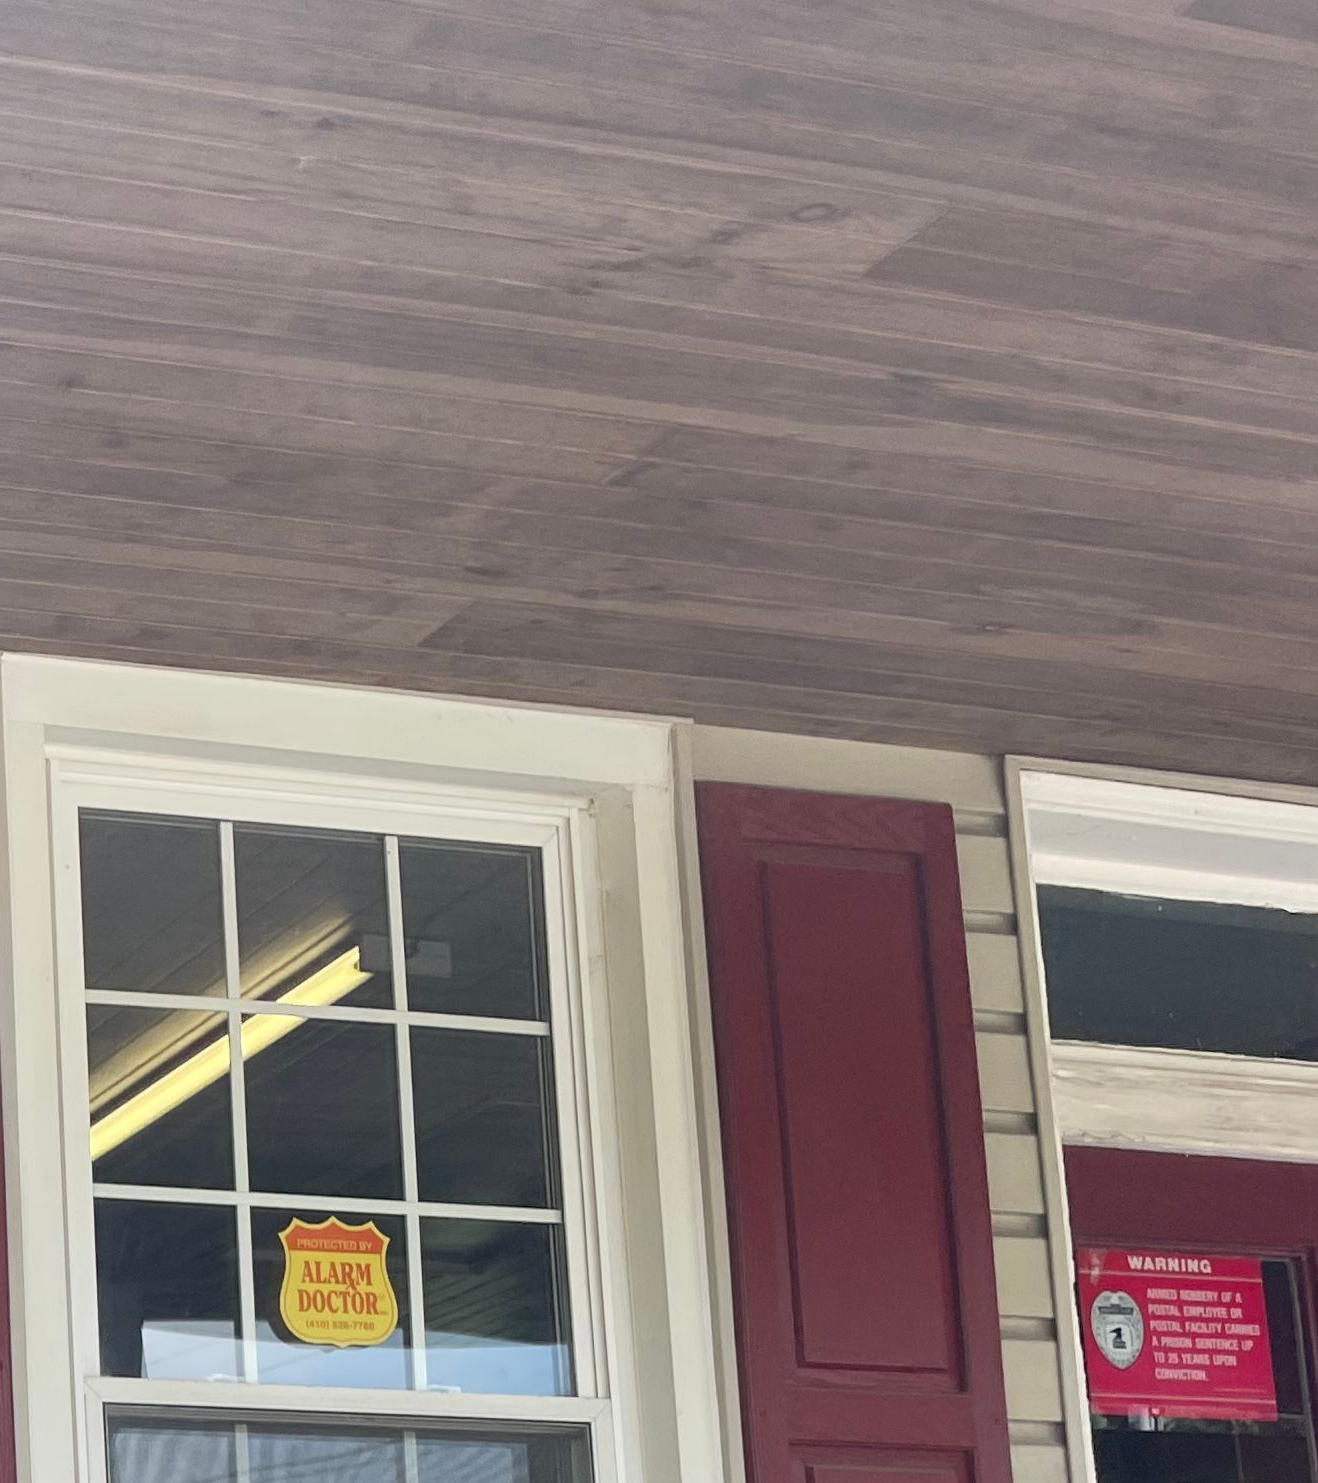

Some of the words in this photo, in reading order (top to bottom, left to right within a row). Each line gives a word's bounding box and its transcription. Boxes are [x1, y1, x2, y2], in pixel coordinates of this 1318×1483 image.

[297, 1238, 356, 1250] PROTECTED
[359, 1240, 372, 1251] BY
[1127, 1255, 1212, 1274] WARNING
[301, 1260, 373, 1288] ALARM
[298, 1289, 379, 1315] DOCTOR
[1221, 1291, 1233, 1303] OF
[1235, 1292, 1242, 1303] A
[1148, 1304, 1181, 1317] POSTAL
[1183, 1305, 1228, 1319] EMPLOYEE
[1230, 1307, 1243, 1319] OR
[1150, 1320, 1183, 1332] POSTAL
[1185, 1321, 1221, 1334] FACILITY
[1152, 1335, 1158, 1346] A
[1161, 1336, 1192, 1349] PRISON
[1195, 1338, 1239, 1351] SENTENCE
[1241, 1339, 1254, 1351] UP
[1154, 1351, 1165, 1363] TO
[1181, 1353, 1210, 1365] YEARS
[1212, 1354, 1237, 1367] UPON
